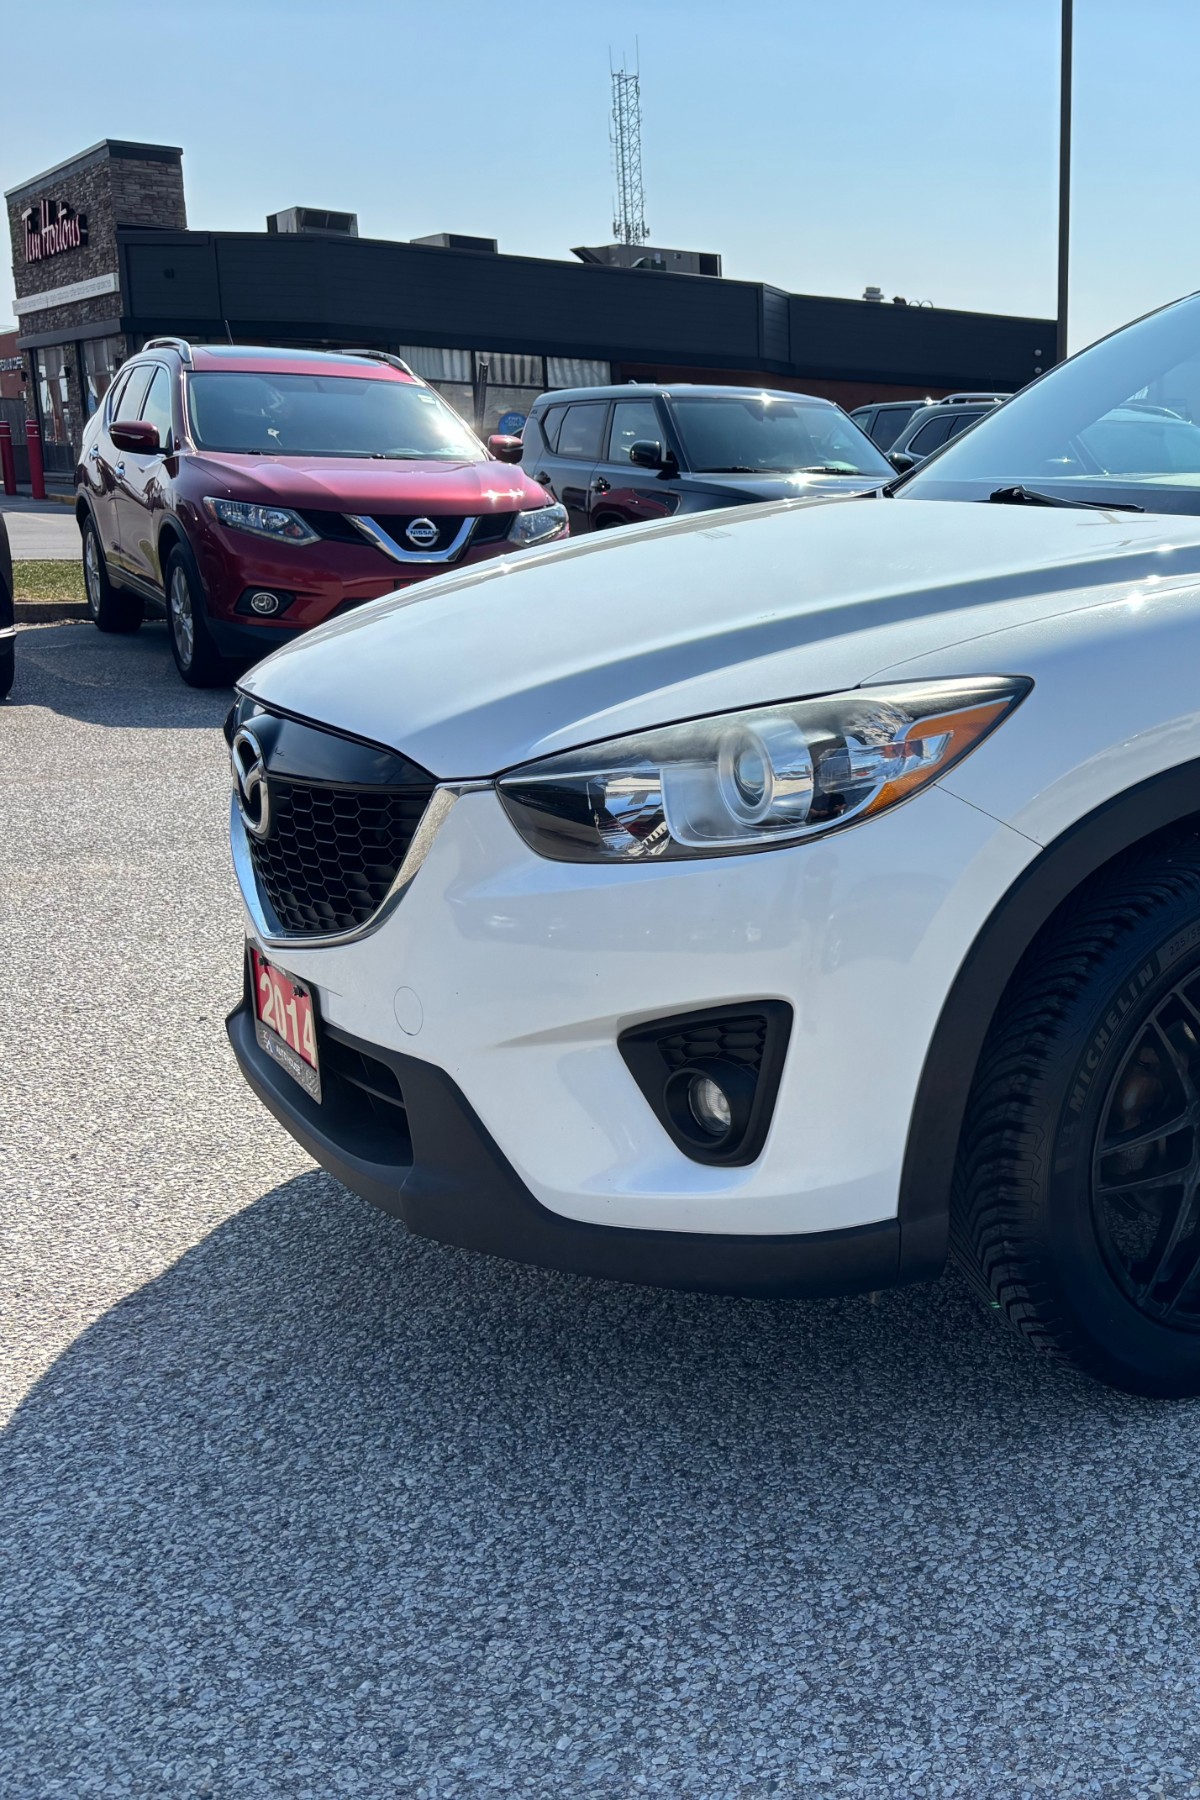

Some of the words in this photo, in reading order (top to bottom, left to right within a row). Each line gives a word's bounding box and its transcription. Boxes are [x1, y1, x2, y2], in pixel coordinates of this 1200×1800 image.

[21, 207, 42, 263] Tim
[41, 199, 84, 257] Hortons
[259, 972, 317, 1069] 2014
[1069, 962, 1156, 1114] MICHELIN
